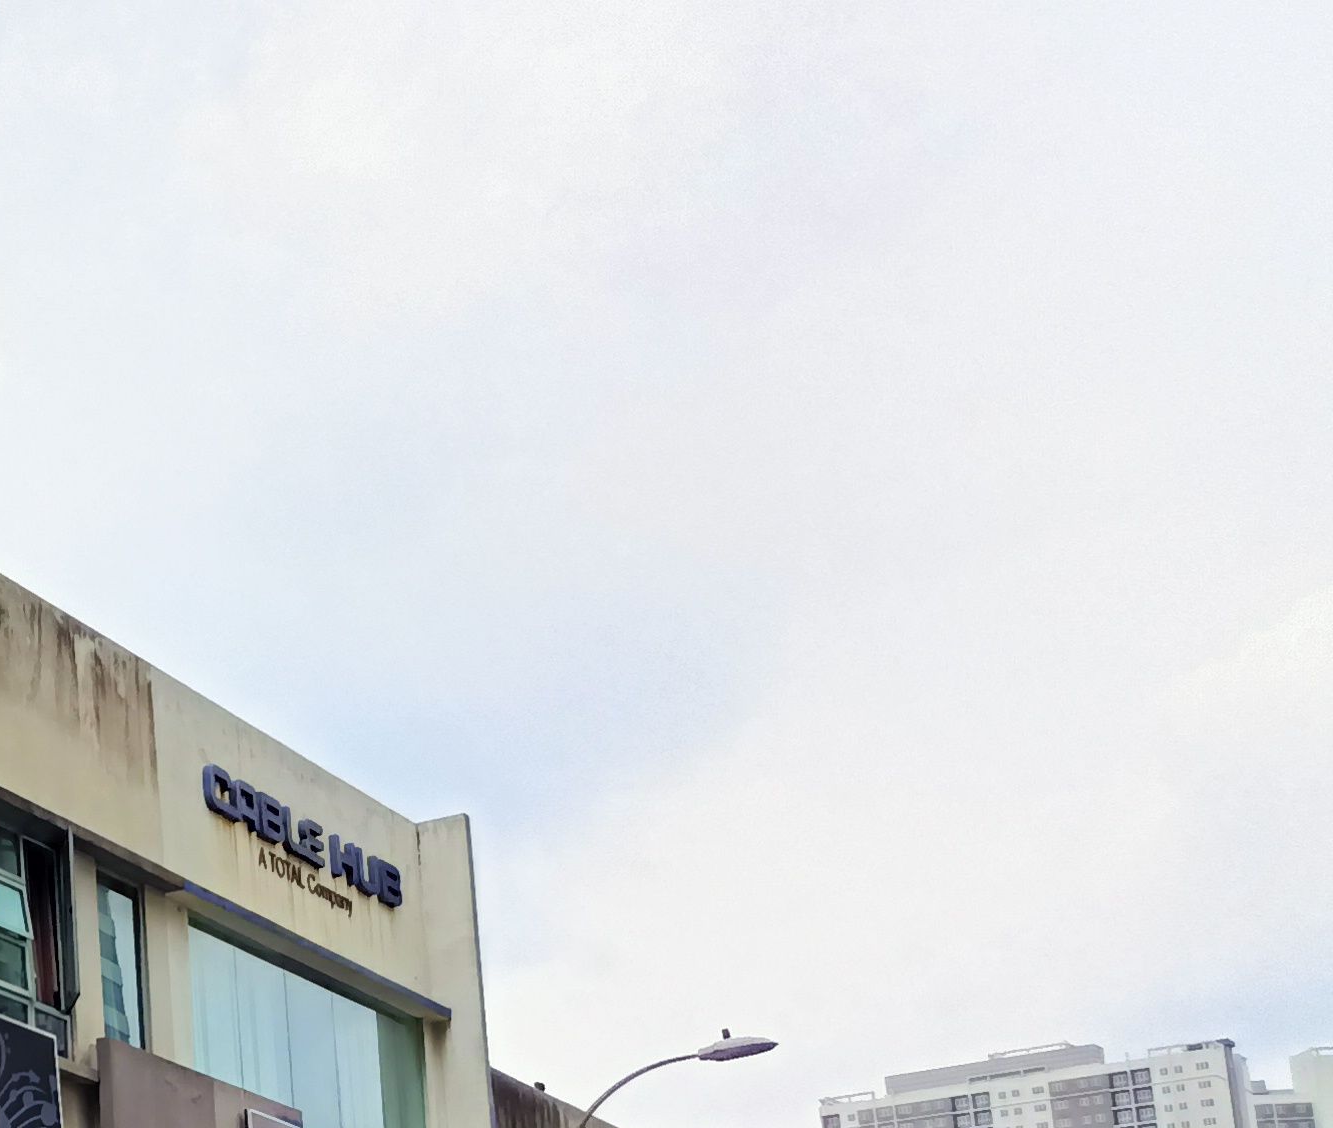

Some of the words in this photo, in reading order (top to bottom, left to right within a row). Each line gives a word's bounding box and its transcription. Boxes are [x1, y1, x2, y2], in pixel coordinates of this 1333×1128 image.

[202, 763, 325, 869] CABLE
[328, 834, 402, 908] HUB
[269, 851, 305, 889] TOTAL
